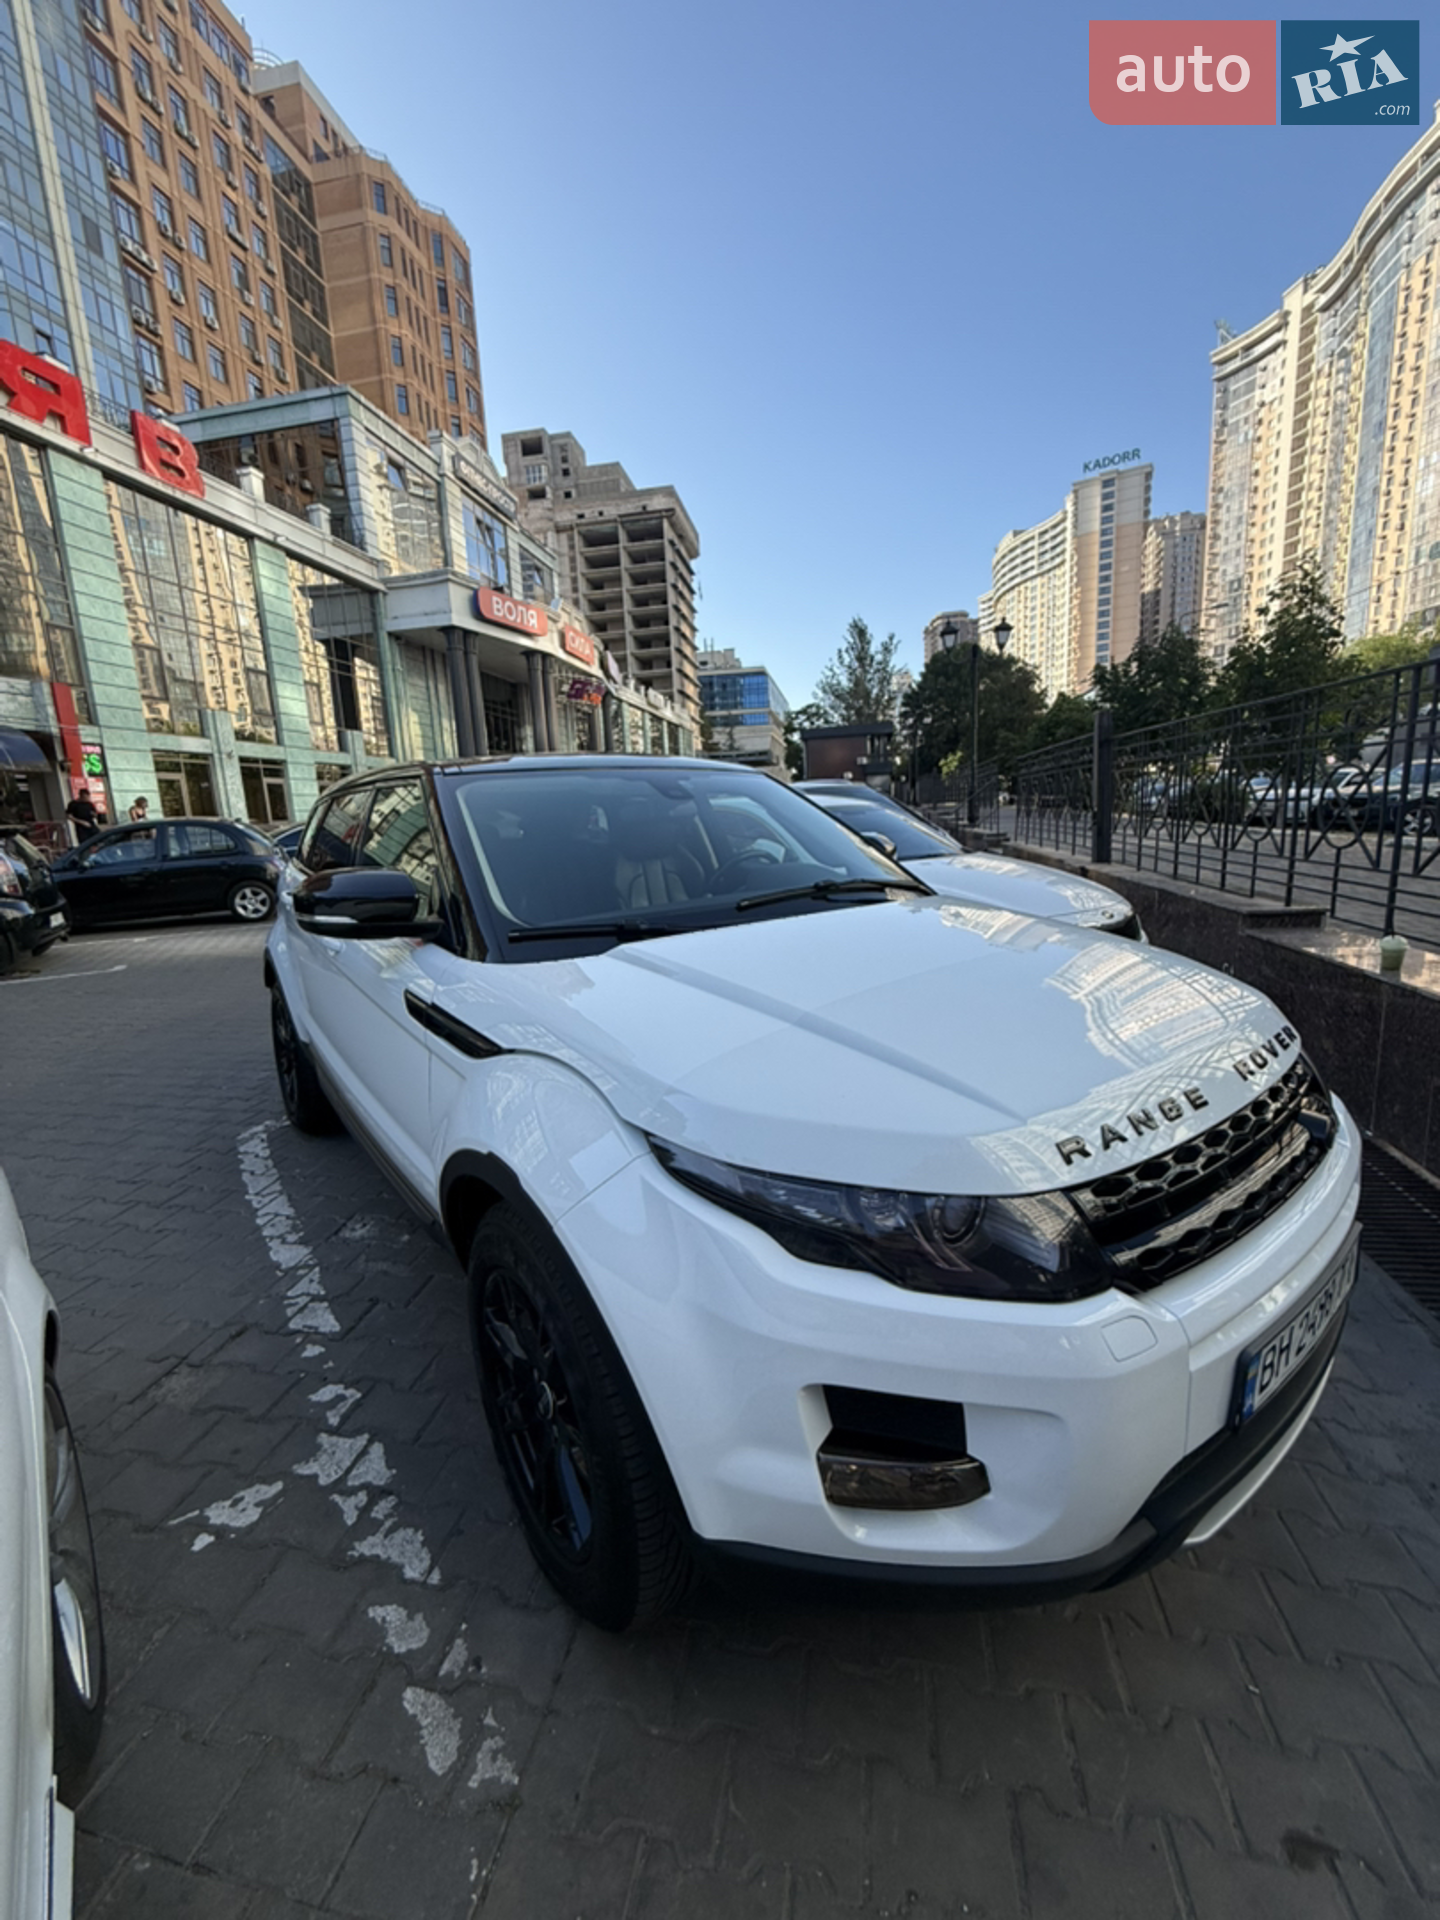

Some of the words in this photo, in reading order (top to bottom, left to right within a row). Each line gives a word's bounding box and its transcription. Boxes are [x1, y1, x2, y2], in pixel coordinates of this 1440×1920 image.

[1082, 448, 1141, 473] KADORR
[492, 596, 537, 629] ВОЛЯ
[1055, 1087, 1210, 1166] RANGE
[1233, 1025, 1298, 1081] ROVER
